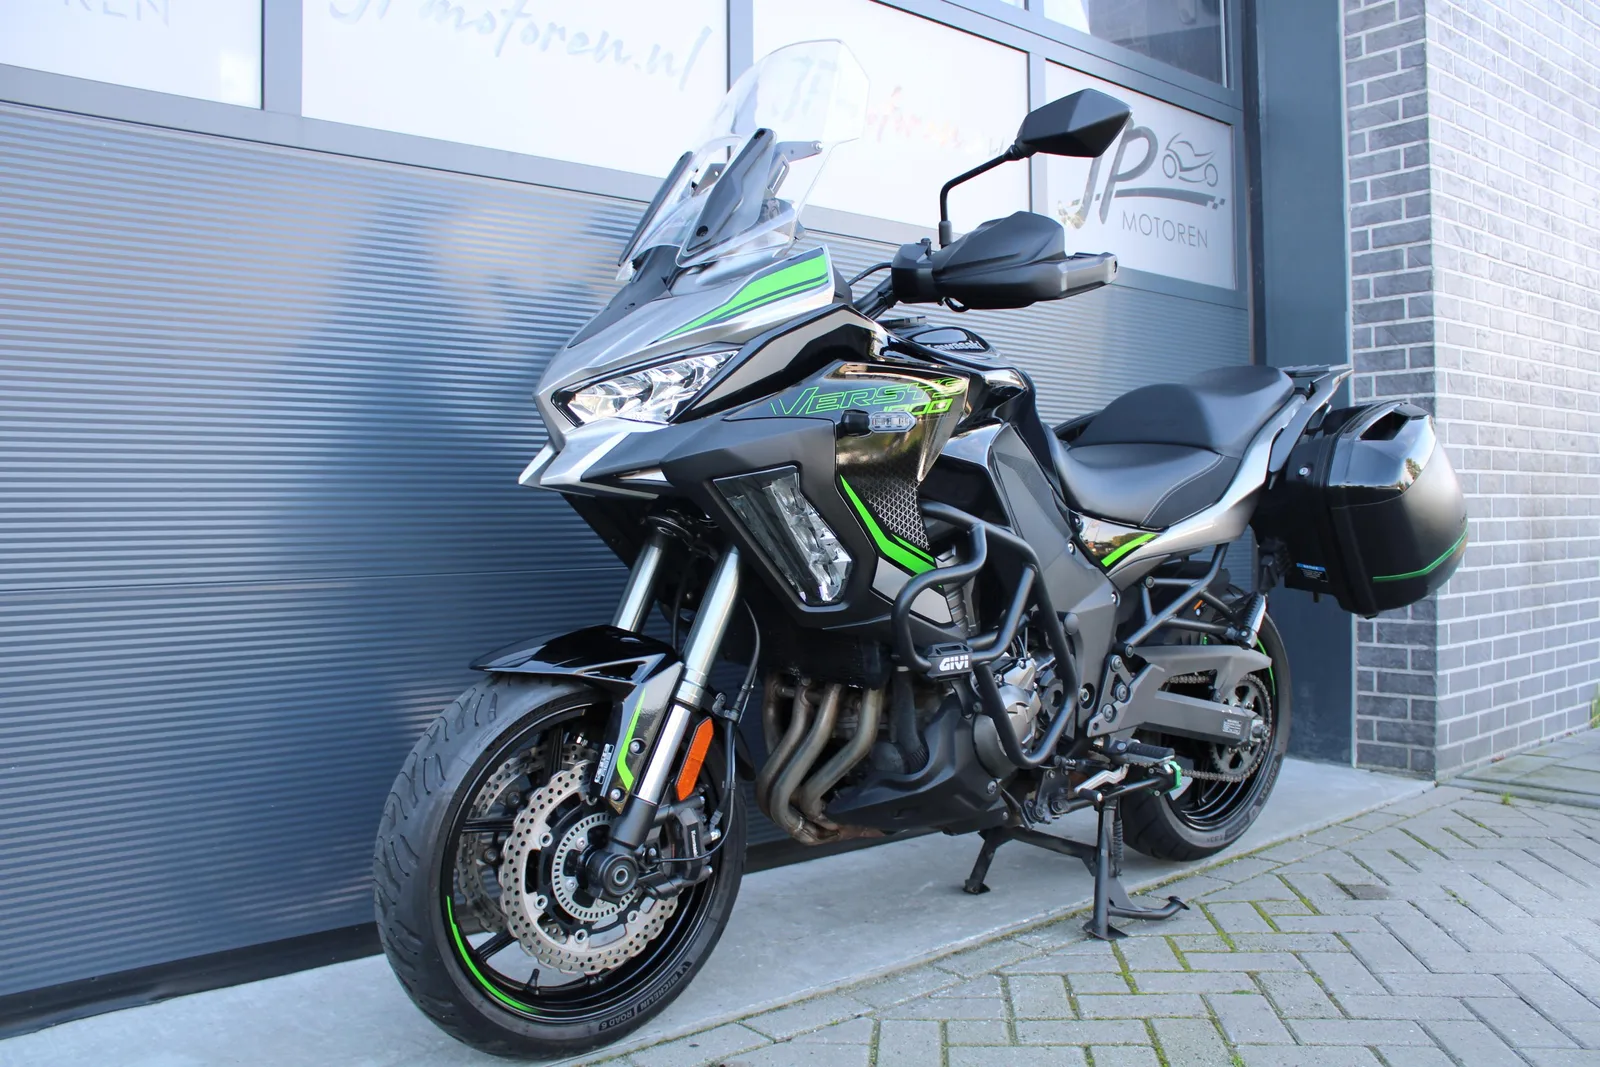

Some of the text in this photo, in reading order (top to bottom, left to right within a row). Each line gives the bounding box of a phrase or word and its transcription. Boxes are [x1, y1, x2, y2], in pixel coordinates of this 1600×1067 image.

[1122, 211, 1208, 249] MOTOREN
[770, 377, 968, 416] VERSYS
[939, 654, 969, 672] GIVI
[601, 974, 680, 1030] MICHELIN ROAD 6
